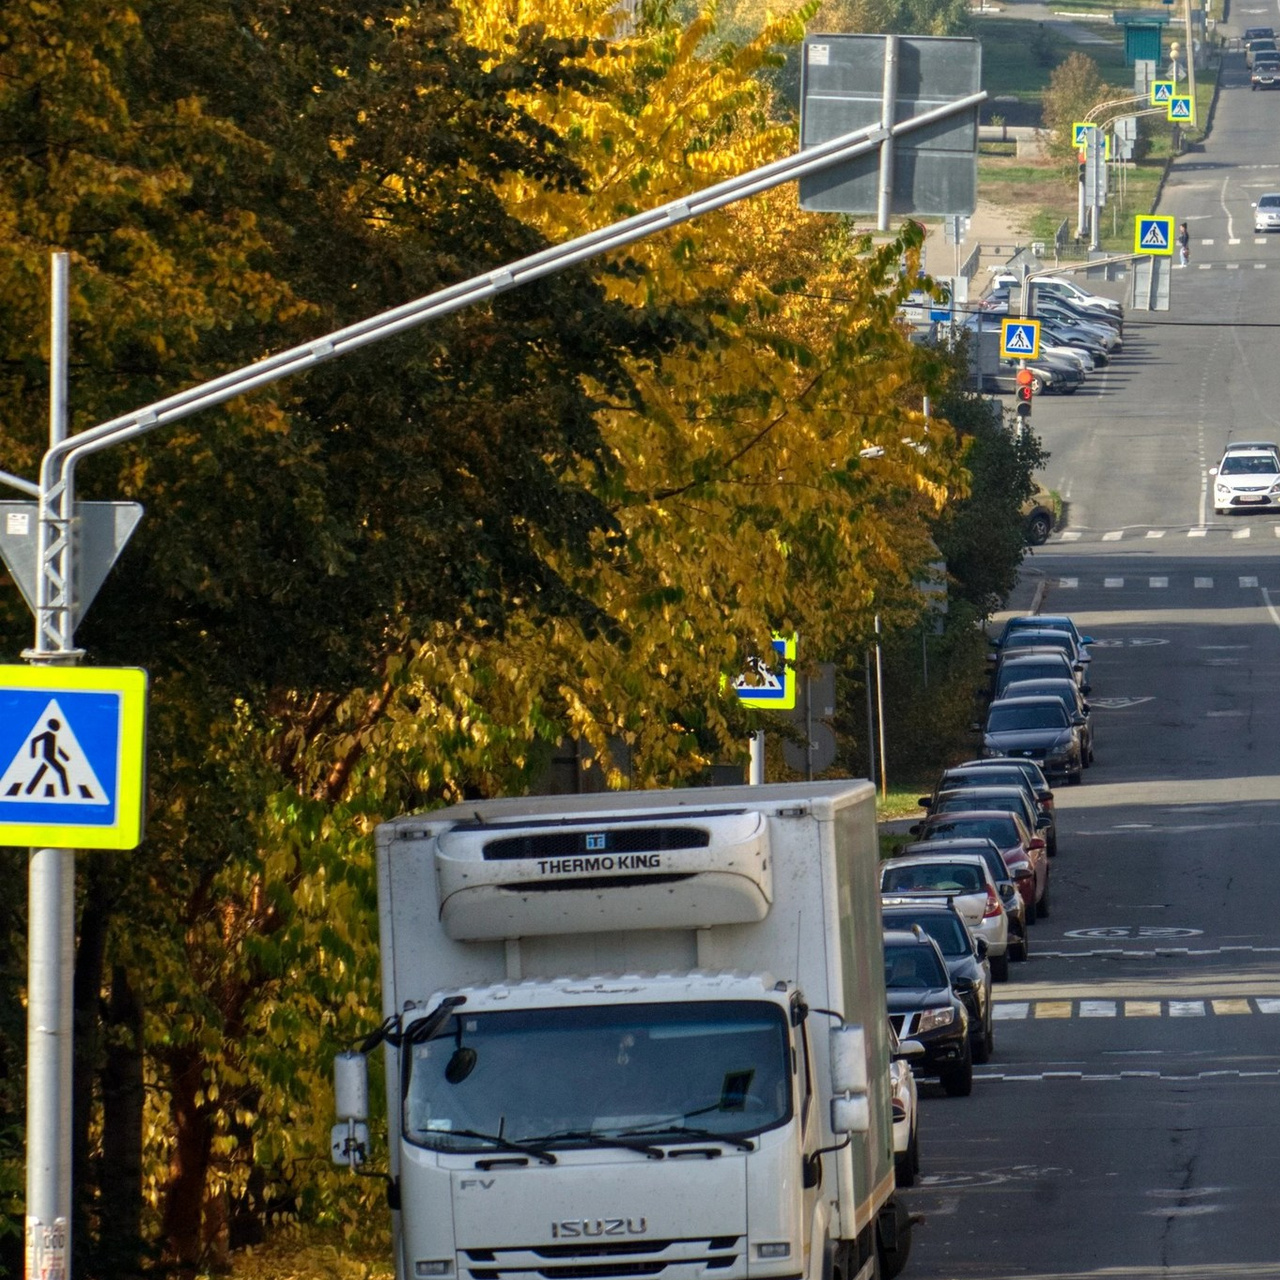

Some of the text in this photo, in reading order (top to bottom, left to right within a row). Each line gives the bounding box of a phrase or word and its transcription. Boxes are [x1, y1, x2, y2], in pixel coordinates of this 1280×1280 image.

[538, 854, 661, 874] THERMO KING
[460, 1178, 496, 1191] FV
[551, 1217, 648, 1239] ISUZU
